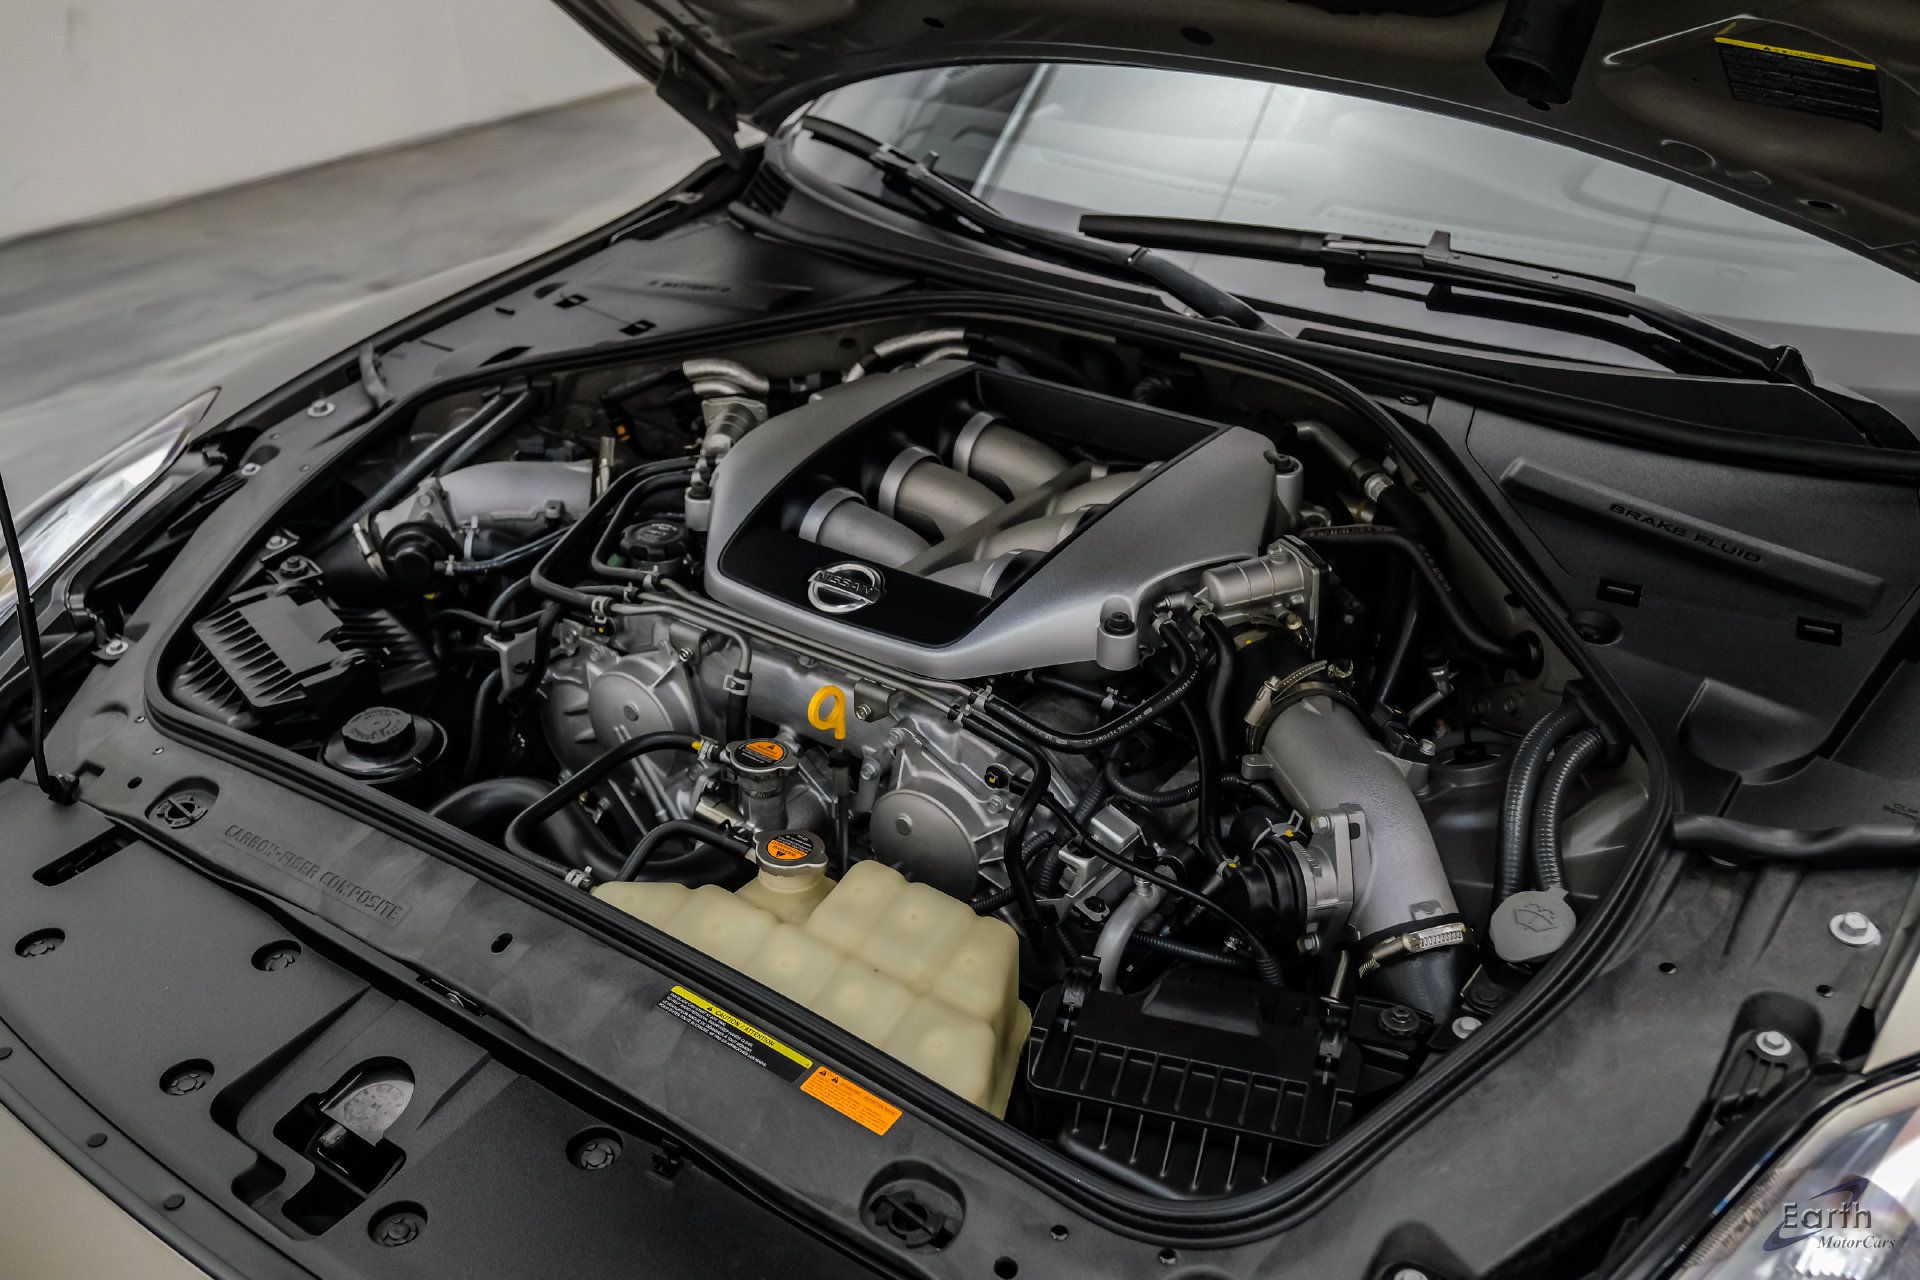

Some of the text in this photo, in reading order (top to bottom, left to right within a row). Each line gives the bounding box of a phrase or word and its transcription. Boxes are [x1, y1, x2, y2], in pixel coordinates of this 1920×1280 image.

[1609, 503, 1762, 562] BRAKE FLUID
[812, 570, 879, 596] NISSAN
[319, 871, 403, 920] COMPOSITE
[715, 1010, 741, 1027] CAUTION
[744, 1026, 775, 1047] ATTENTION
